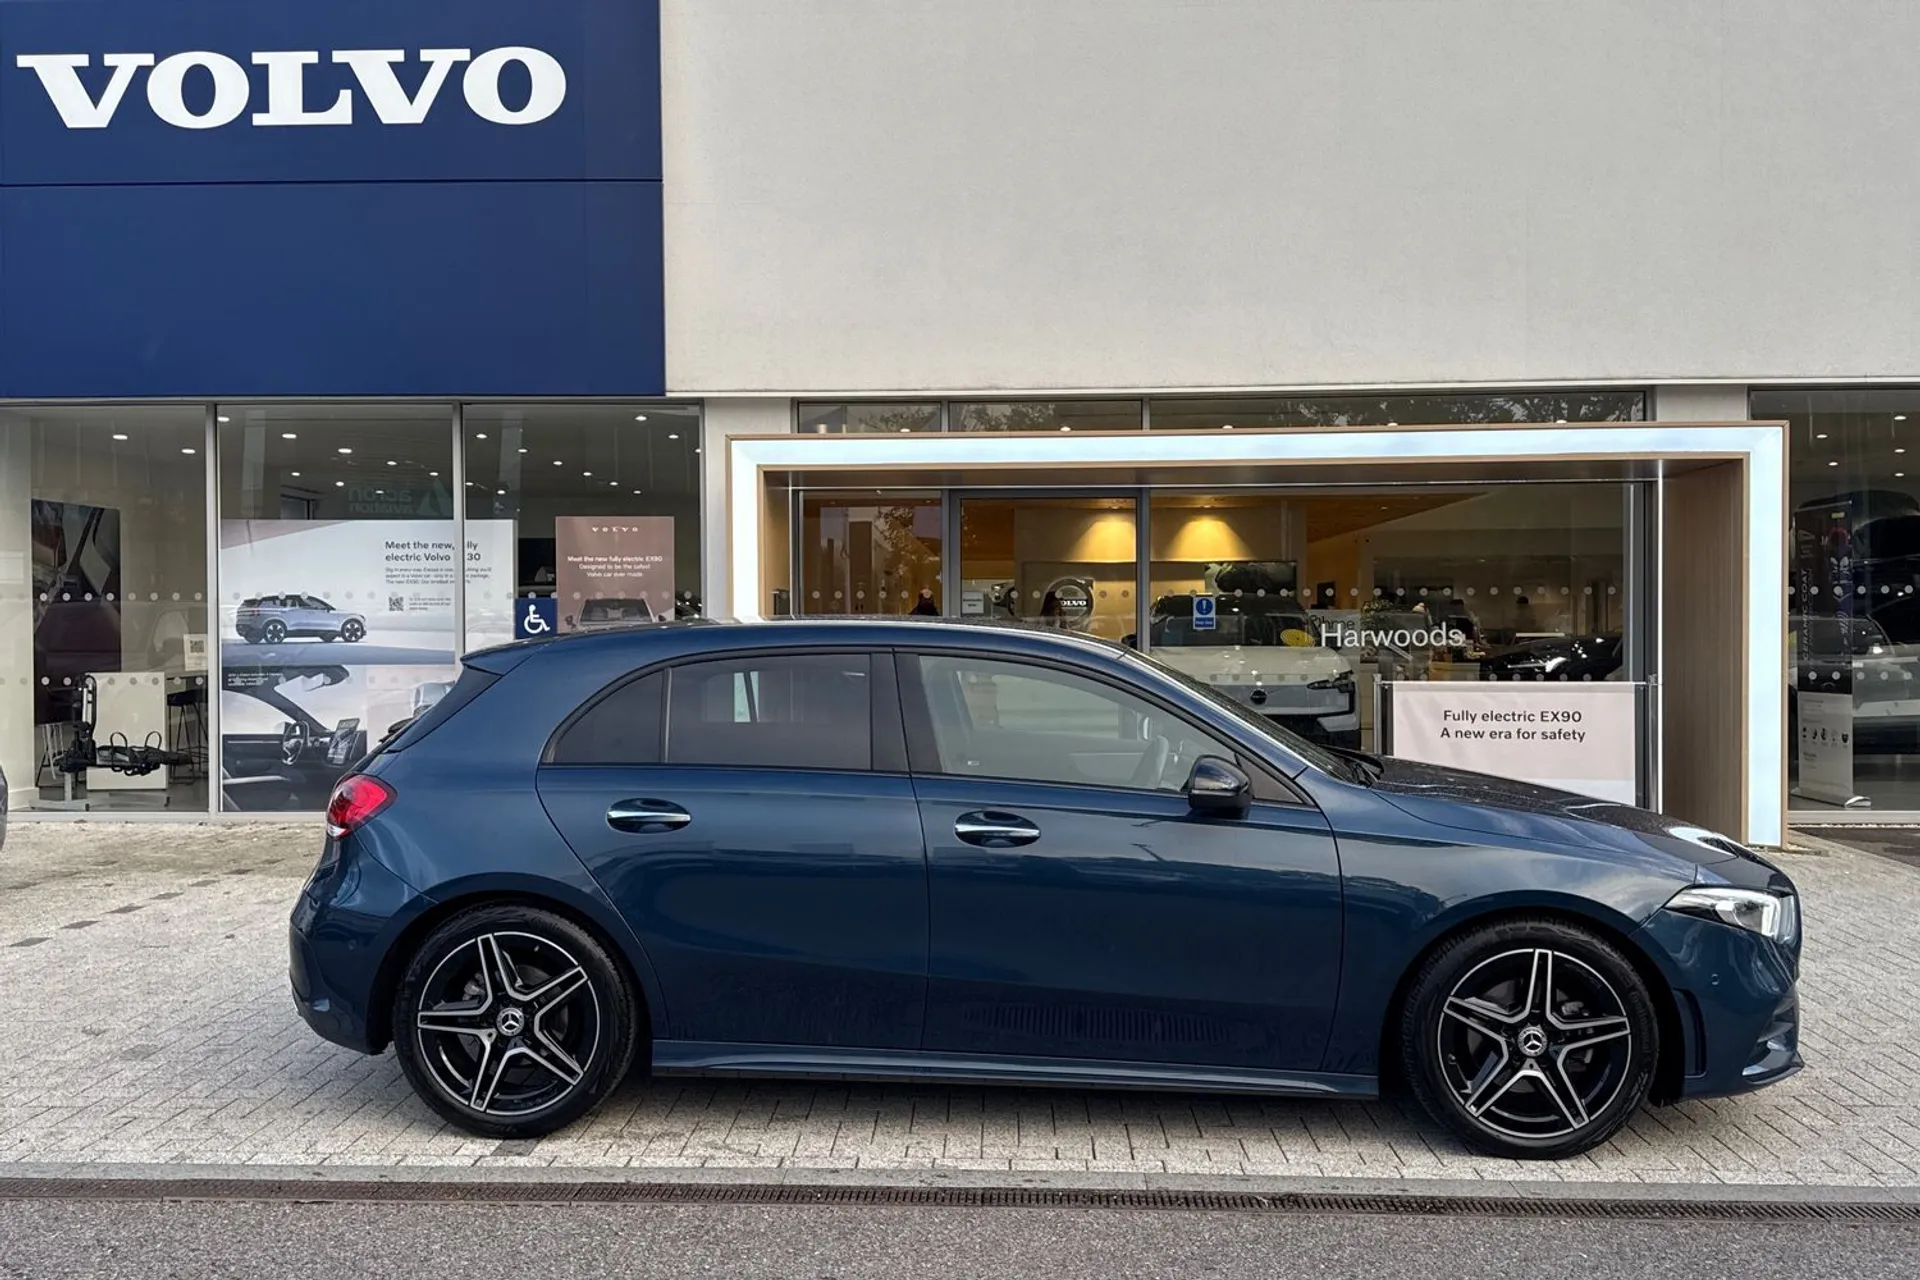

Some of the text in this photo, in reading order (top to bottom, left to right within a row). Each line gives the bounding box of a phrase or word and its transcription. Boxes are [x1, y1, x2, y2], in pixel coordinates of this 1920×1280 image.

[17, 46, 567, 129] VOLVO
[385, 541, 478, 550] Meet the new, lly
[385, 553, 481, 561] electric Volvo 30
[579, 563, 606, 571] Designed
[1321, 621, 1464, 647] Harwoods
[1443, 710, 1582, 724] Fully electric EX90
[1440, 727, 1586, 743] A new era for safety
